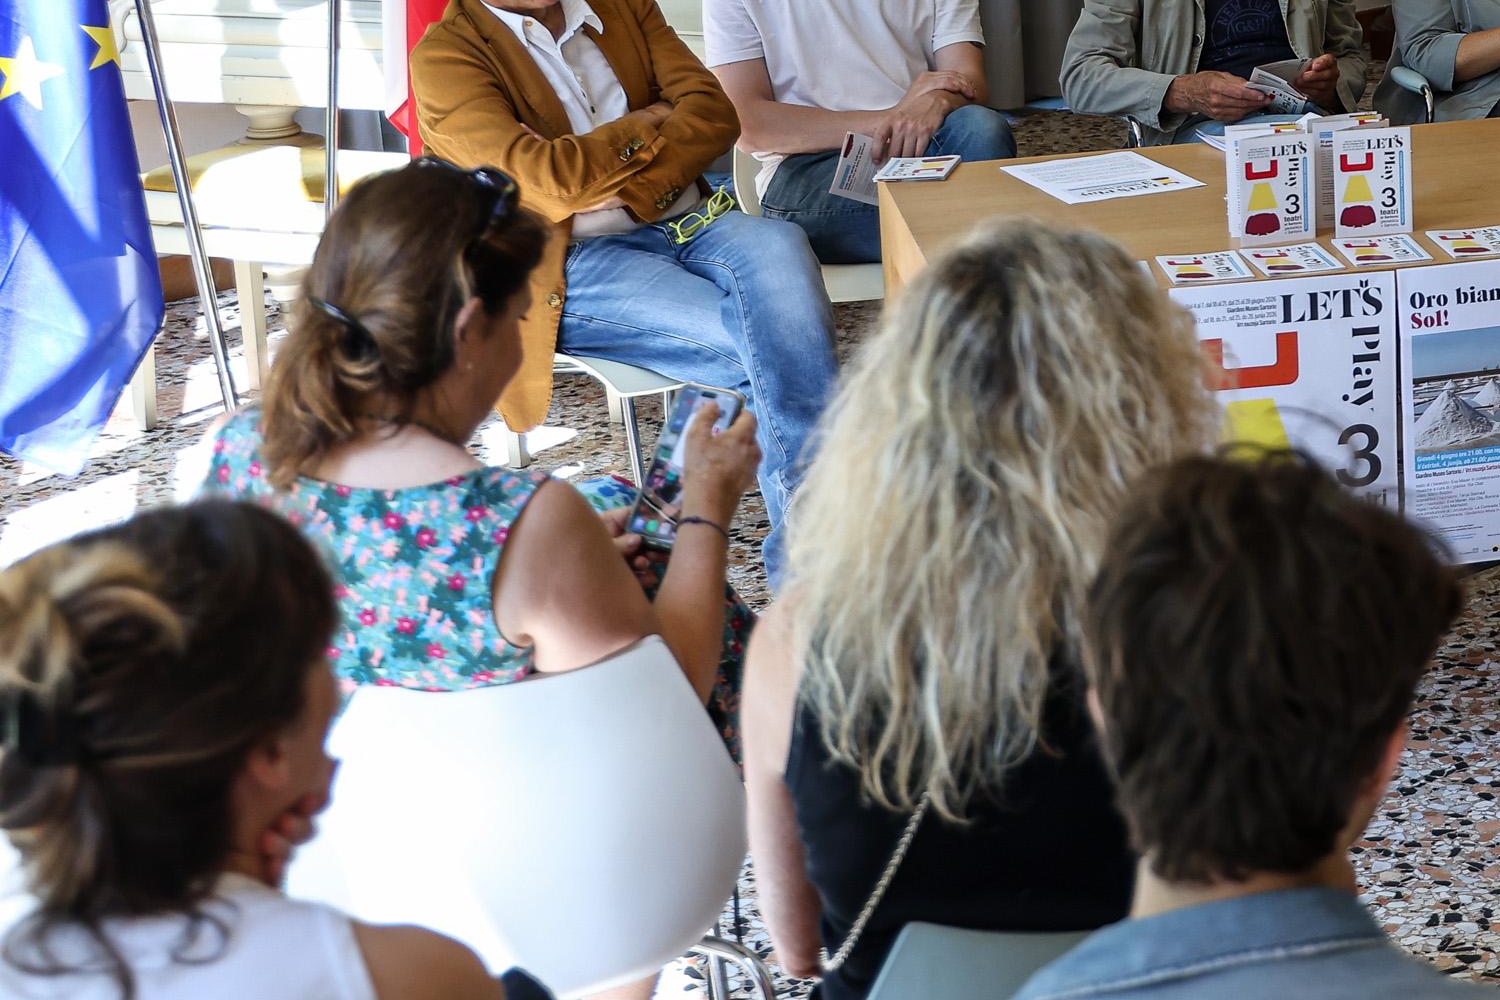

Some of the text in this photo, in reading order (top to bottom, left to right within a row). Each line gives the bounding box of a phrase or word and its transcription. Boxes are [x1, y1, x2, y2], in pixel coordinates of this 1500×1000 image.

[1285, 157, 1300, 188] Play
[1381, 151, 1396, 181] Play
[1285, 193, 1301, 215] 3
[1381, 187, 1397, 208] 3
[1284, 214, 1303, 222] teatri
[1380, 207, 1399, 215] teatri
[1410, 291, 1449, 310] Oro
[1411, 310, 1449, 330] Sol!
[1342, 325, 1381, 411] Play
[1335, 423, 1382, 488] 3
